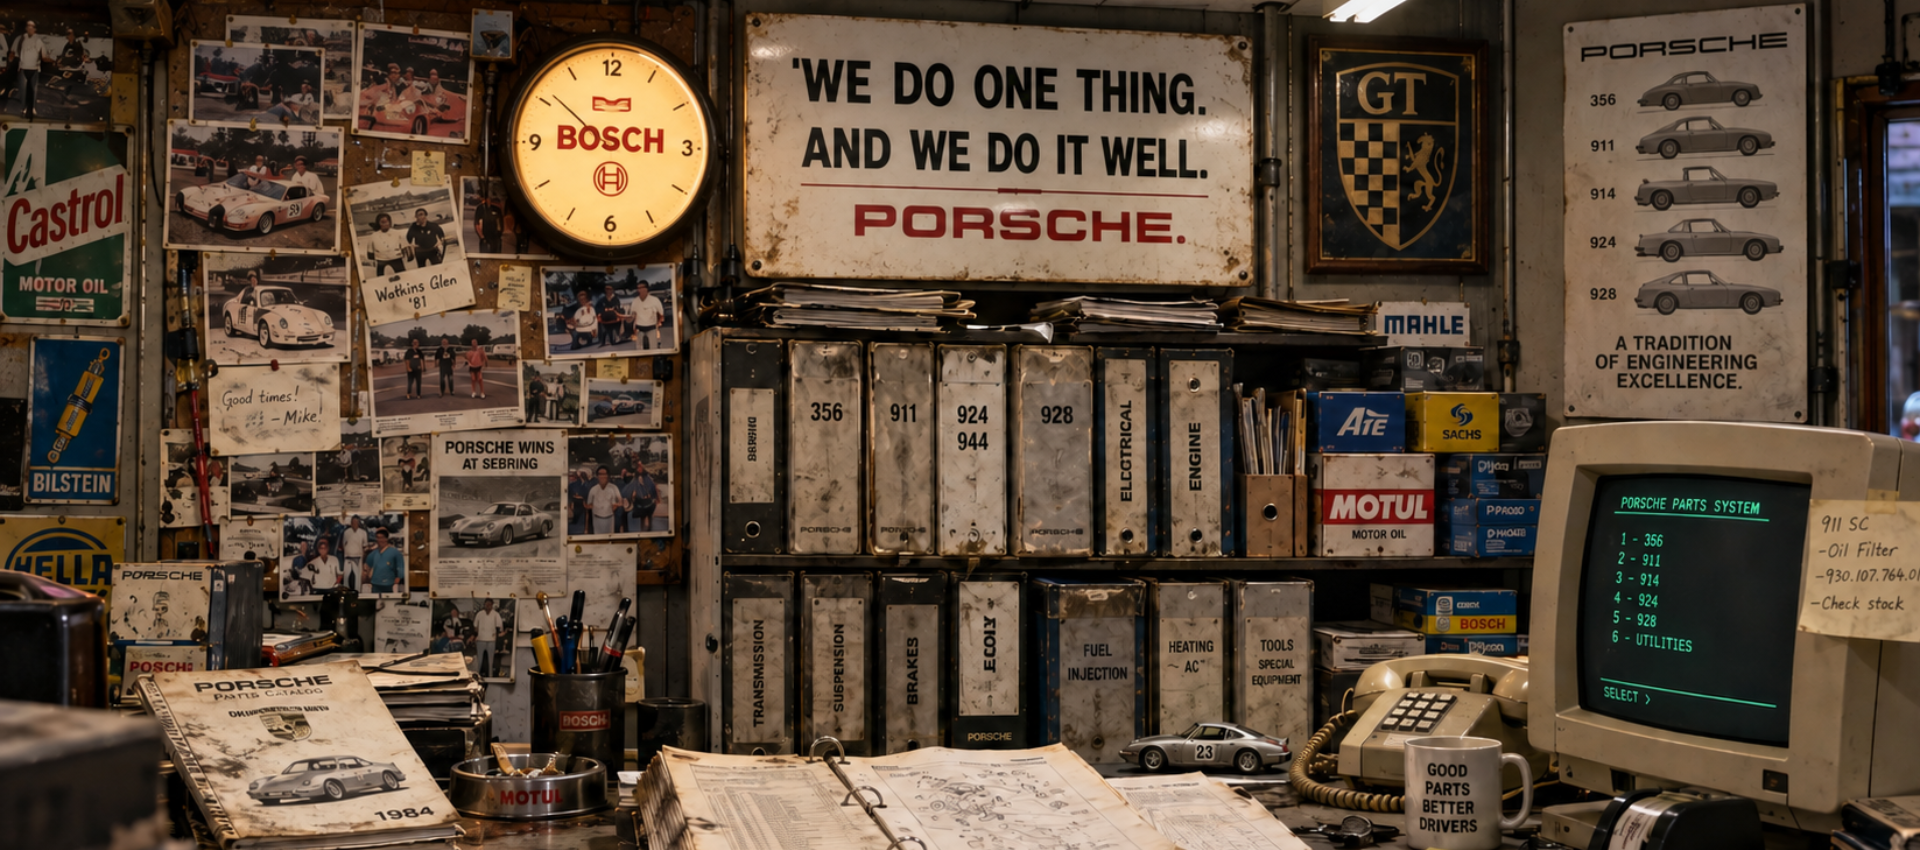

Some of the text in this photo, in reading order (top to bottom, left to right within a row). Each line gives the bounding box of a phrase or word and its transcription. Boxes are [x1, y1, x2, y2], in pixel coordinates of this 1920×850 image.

[1581, 32, 1787, 62] PORSCHE
[602, 59, 622, 77] 12
[894, 61, 954, 107] DO
[974, 65, 1058, 110] ONE
[1076, 69, 1206, 115] THING.
[1357, 71, 1427, 115] GT
[1590, 94, 1616, 107] 356
[529, 134, 542, 151] 9
[557, 125, 664, 154] BOSCH
[681, 140, 693, 156] 3
[1590, 140, 1614, 152] 911
[802, 127, 1208, 179] AND WE DO IT WELL.
[1590, 188, 1616, 200] 914
[7, 173, 124, 254] Castrol
[604, 215, 617, 232] 6
[854, 204, 1186, 244] PORSCHE.
[1590, 236, 1616, 249] 924
[19, 276, 108, 294] MOTOR OIL
[430, 274, 457, 290] Glen
[1590, 288, 1617, 300] 928
[1384, 315, 1464, 335] MAHLE
[1615, 335, 1732, 350] A TRADITION
[1595, 354, 1758, 370] OF ENGINEERING
[1617, 373, 1743, 390] EXCELLENCE.
[222, 385, 299, 411] Good times!
[811, 402, 843, 422] 356
[890, 403, 917, 422] 911
[957, 405, 988, 424] 924
[1041, 405, 1074, 424] 928
[957, 432, 989, 451] 944
[1442, 429, 1482, 440] SACHS
[445, 441, 555, 454] PORSCHE WINS
[462, 458, 538, 470] AT SEBRING
[1189, 422, 1202, 492] ENGINE
[33, 473, 111, 493] BILSTEIN
[1329, 494, 1428, 520] MOTUL
[1621, 496, 1760, 515] PORSCHE PARTS SYSTEM
[1821, 515, 1869, 533] 911 SC
[1352, 529, 1406, 540] MOTOR OIL
[1621, 532, 1626, 545] 1
[1644, 533, 1663, 547] 356
[1857, 541, 1899, 558] Filter
[1618, 551, 1625, 565] 2
[1642, 553, 1661, 567] 911
[14, 554, 112, 585] HELLA
[122, 571, 203, 581] PORSCHE
[1615, 570, 1623, 584] 3
[1640, 572, 1660, 587] 914
[1613, 591, 1621, 604] 4
[1638, 593, 1658, 608] 924
[1867, 595, 1904, 610] stock
[1460, 618, 1506, 629] BOSCH
[1612, 610, 1620, 624] 5
[1637, 613, 1657, 628] 928
[1169, 640, 1214, 653] HEATING
[1260, 639, 1294, 652] TOOLS
[1611, 630, 1619, 643] 6
[1636, 633, 1693, 653] UTILITIES
[1083, 644, 1112, 657] FUEL
[907, 637, 919, 705] BRAKES
[1258, 659, 1295, 669] SPECIAL
[753, 619, 764, 728] TRANSMISSION
[1067, 666, 1128, 681] INJECTION
[194, 675, 333, 693] PORSCHE
[1603, 686, 1638, 703] SELECT
[563, 714, 606, 727] BOSCH
[968, 732, 1012, 742] PORSCHE
[1196, 745, 1213, 760] 23
[1427, 763, 1468, 778] GOOD
[501, 788, 563, 806] MOTUL
[1425, 781, 1470, 796] PARTS
[375, 806, 434, 821] 1984
[1422, 799, 1474, 815] BETTER
[1419, 817, 1478, 833] DRIVERS
